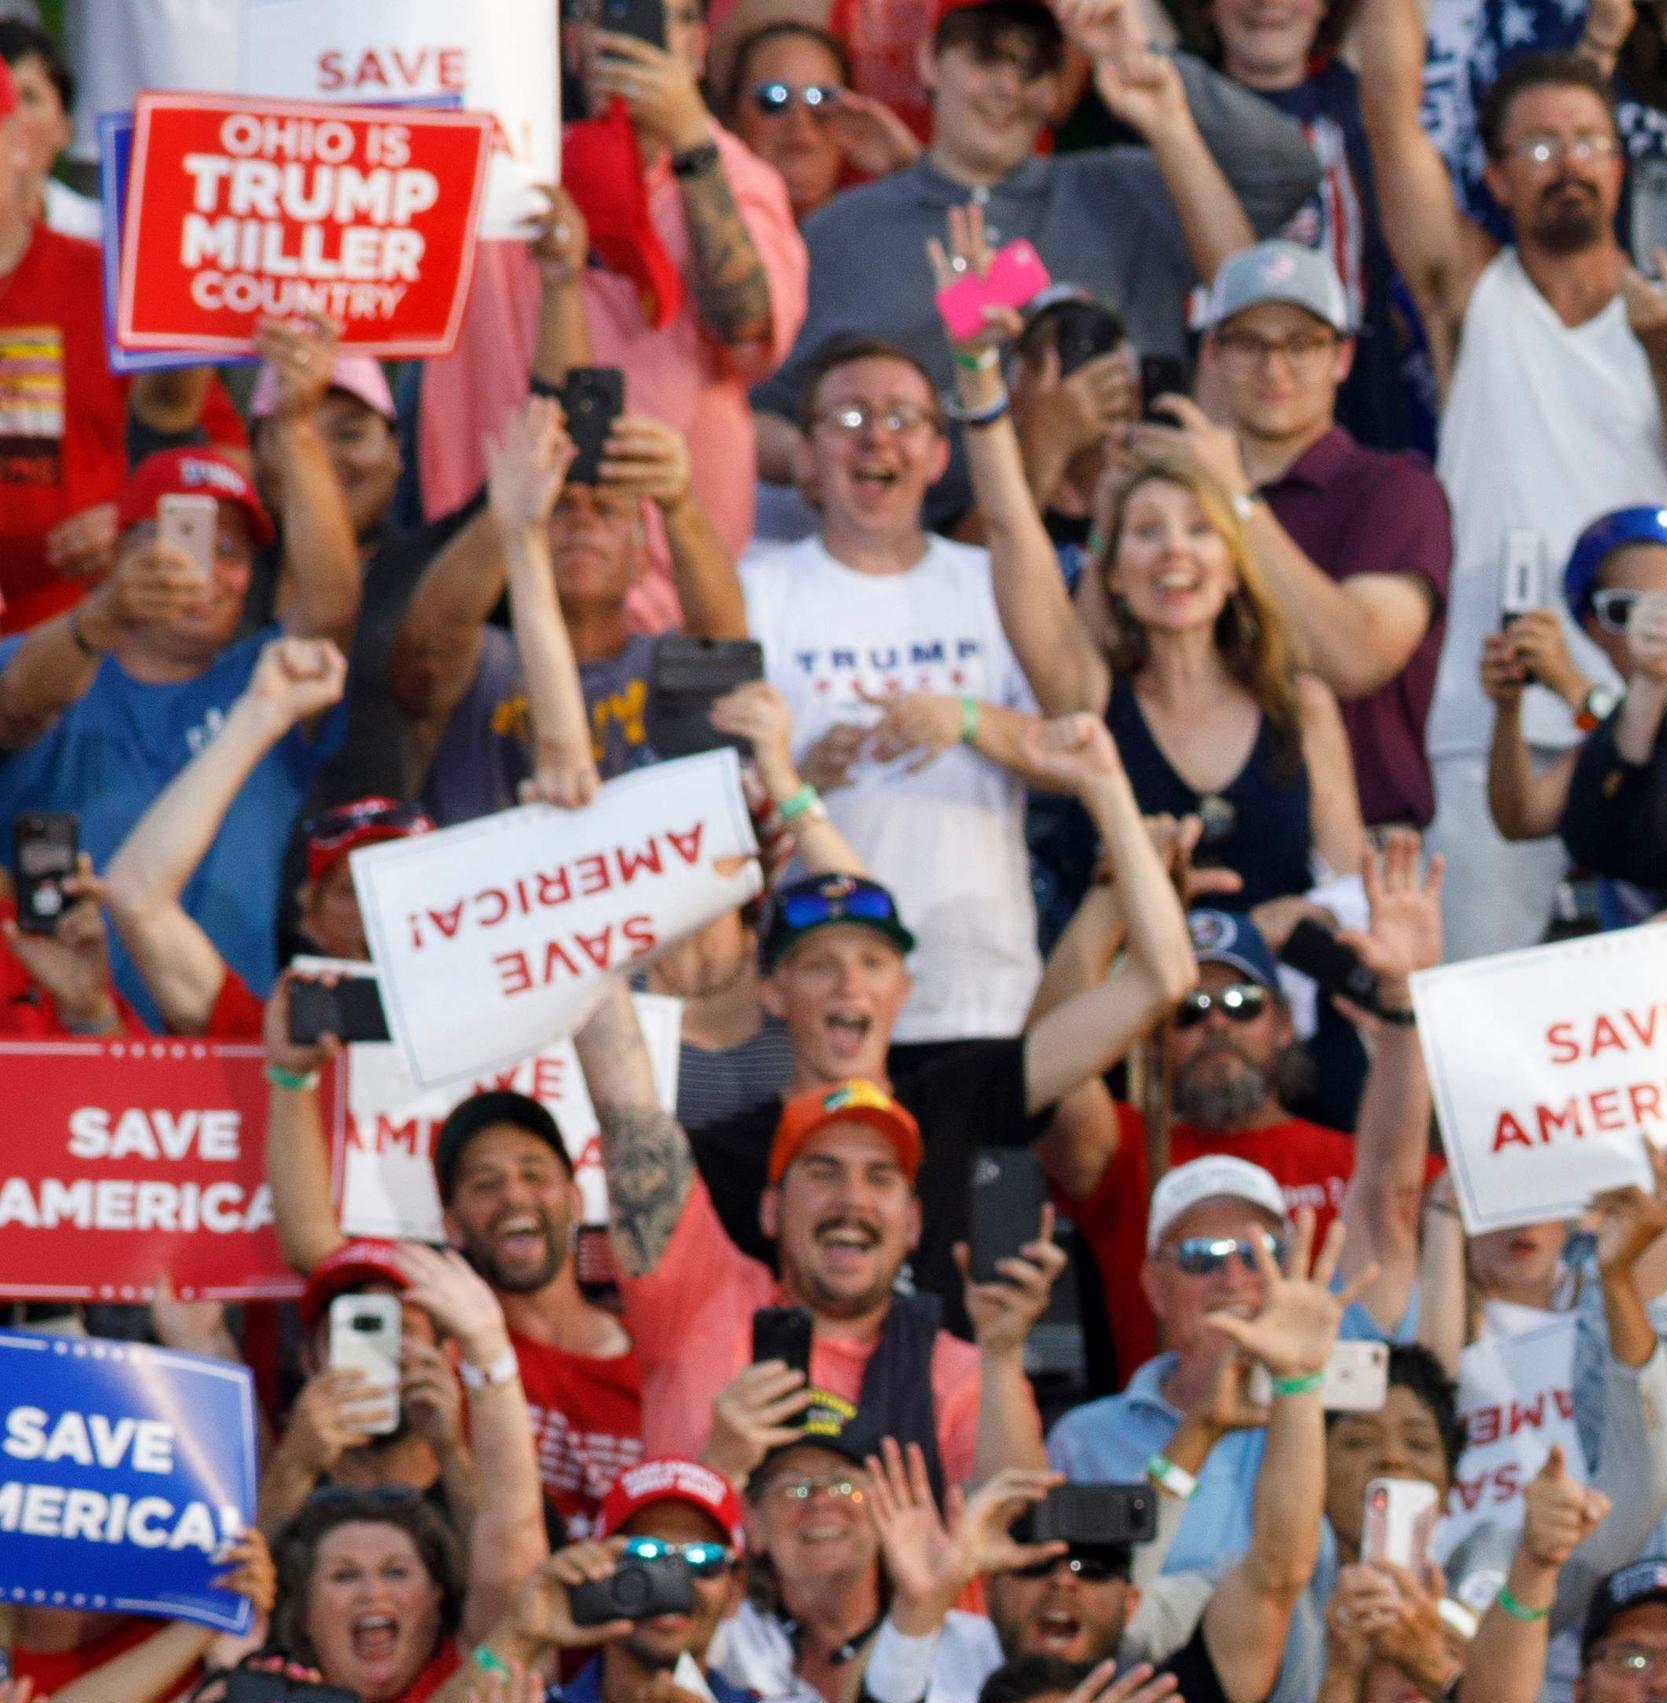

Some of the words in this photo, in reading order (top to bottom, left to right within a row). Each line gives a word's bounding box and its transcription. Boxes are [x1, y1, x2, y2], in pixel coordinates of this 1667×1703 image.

[316, 48, 467, 91] SAVE
[220, 114, 355, 164] OHIO
[365, 124, 411, 166] IS
[183, 153, 440, 226] TRUMP
[180, 213, 426, 282] MILLER
[190, 269, 408, 320] COUNTRY
[795, 639, 982, 676] TRUMP
[411, 820, 706, 951] AMERICA!
[493, 914, 657, 997] SAVE
[68, 1108, 240, 1161] SAVE
[2, 1407, 174, 1474] SAVE
